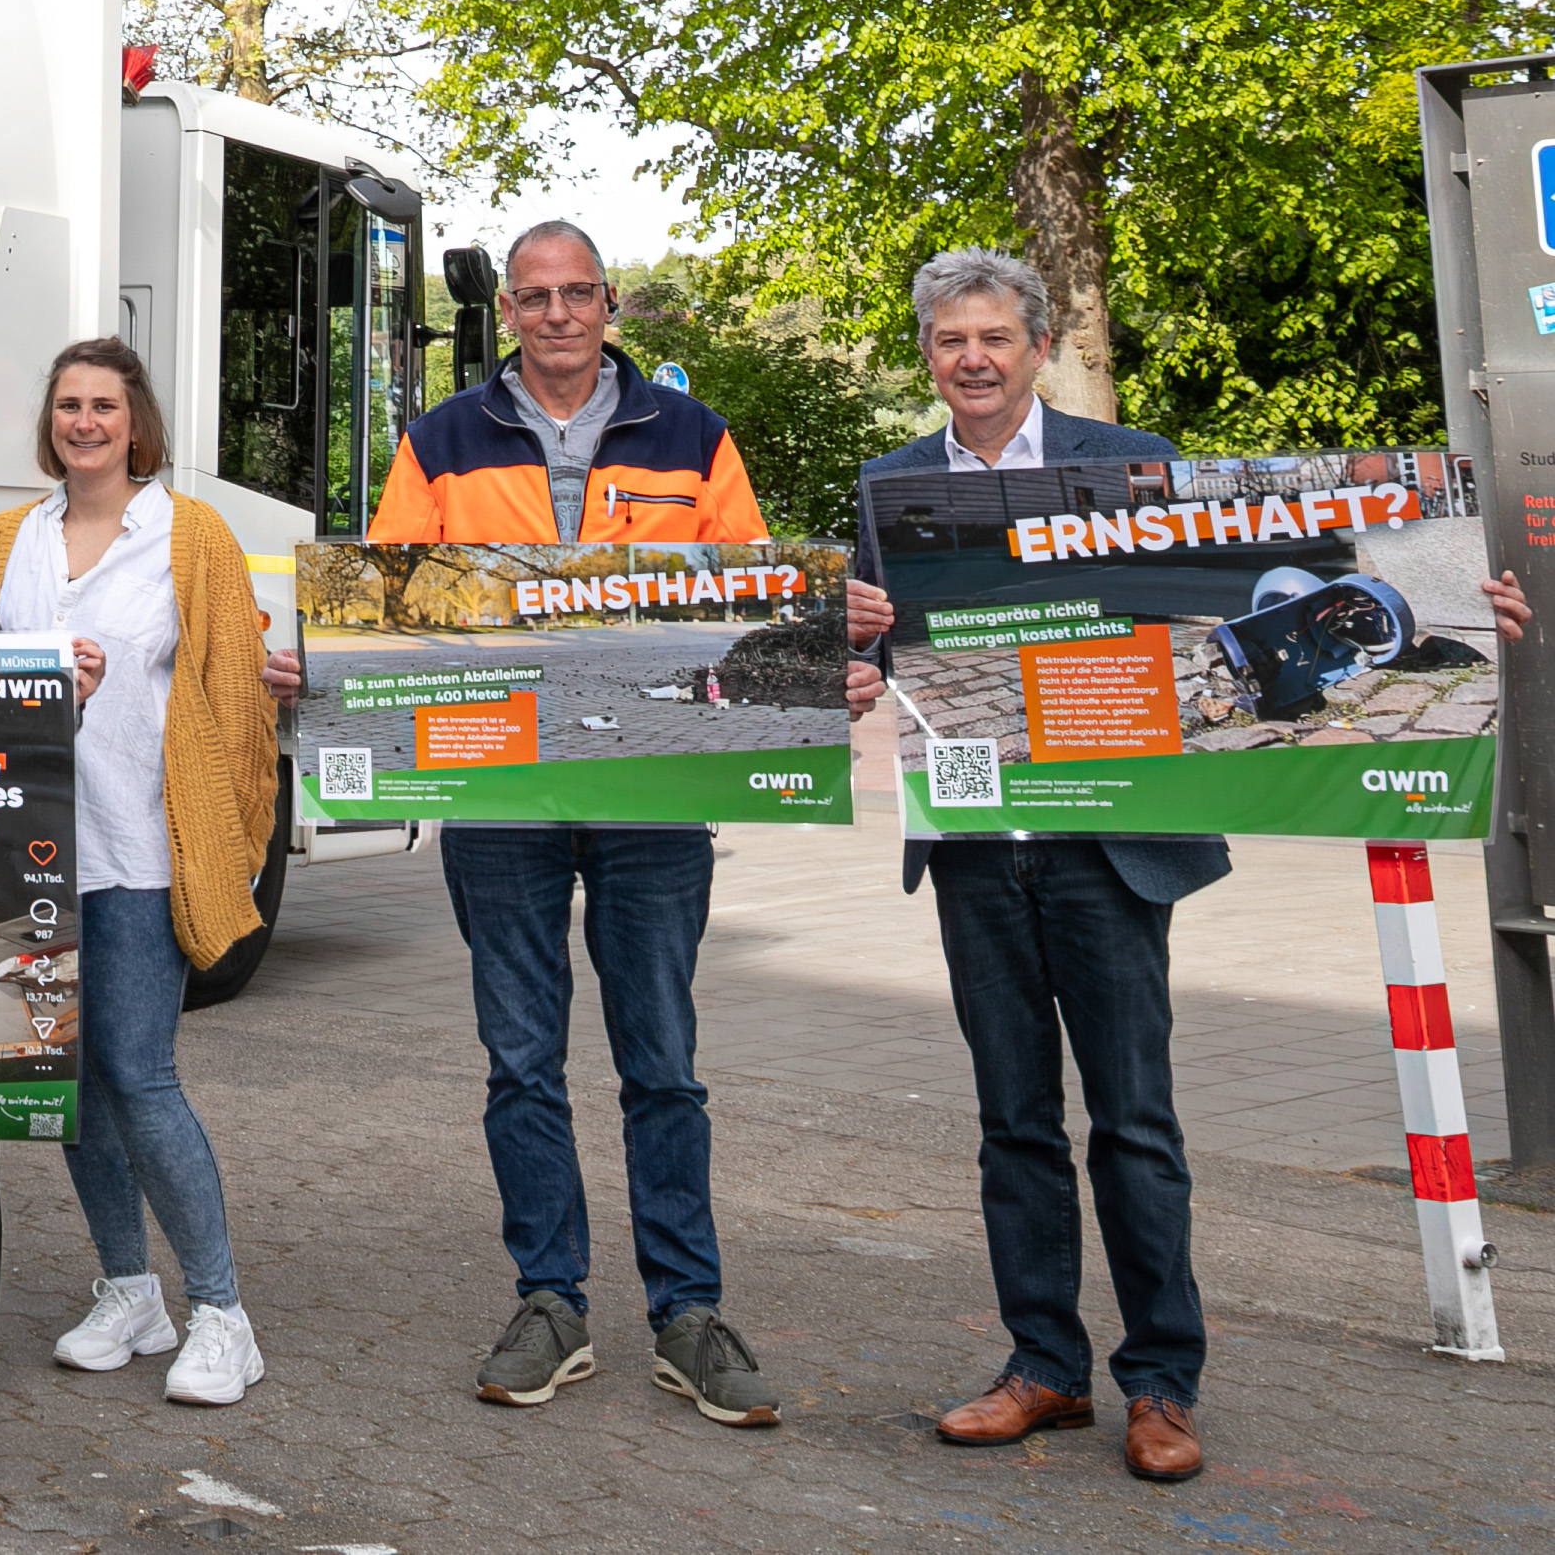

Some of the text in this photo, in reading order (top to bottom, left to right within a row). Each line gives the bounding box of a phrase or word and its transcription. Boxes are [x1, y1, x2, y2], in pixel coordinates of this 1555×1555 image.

[1014, 481, 1409, 564] ERNSTHAFT?
[1525, 513, 1547, 527] für
[516, 564, 800, 615] ERNSTHAFT?
[929, 600, 1099, 628] Elektrogeräte richtig
[934, 621, 1132, 649] entsorgen kostet nichts.
[1, 654, 56, 669] MÜNSTER
[344, 668, 543, 691] Bis zum nächsten Abfalleimer
[346, 688, 508, 709] sind es keine 400 Meter.
[749, 773, 813, 790] awm
[1362, 769, 1448, 793] awm
[23, 873, 65, 884] 94,1 Tsd.
[35, 929, 53, 939] 987
[26, 992, 66, 1003] 13,7 Tsd.
